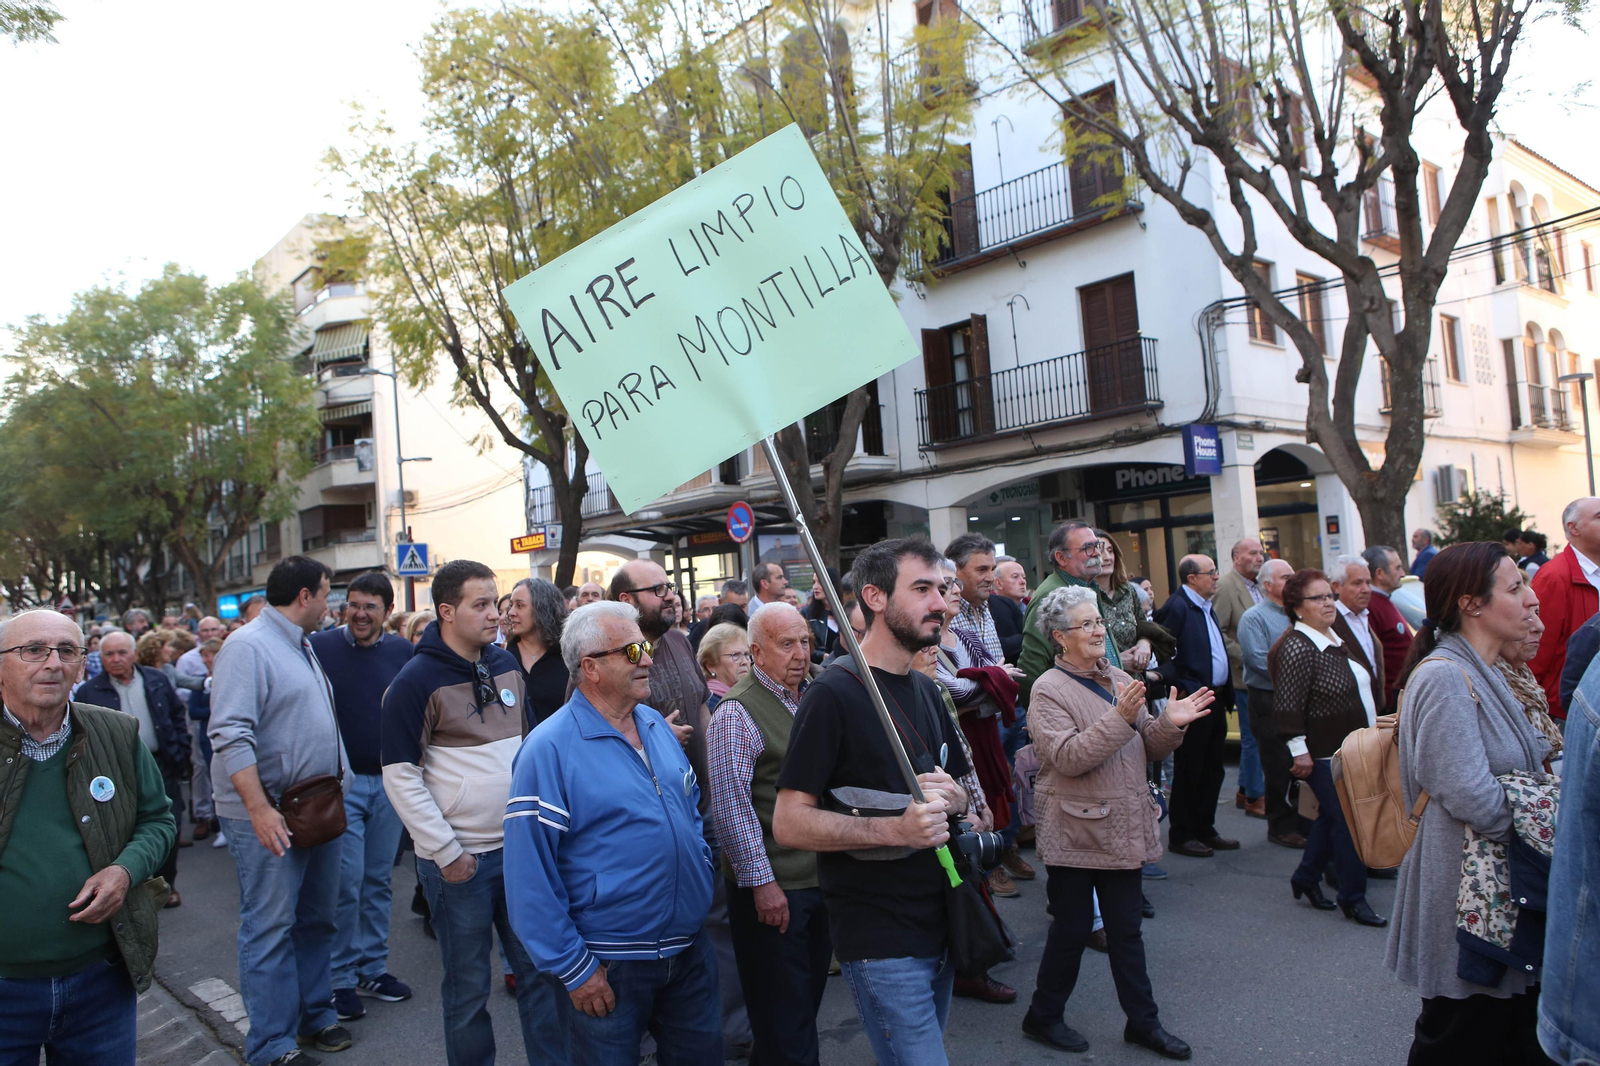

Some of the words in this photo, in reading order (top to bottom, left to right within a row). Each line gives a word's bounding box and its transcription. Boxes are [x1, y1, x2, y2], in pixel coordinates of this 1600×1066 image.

[541, 256, 656, 371] AIRE
[667, 175, 806, 277] LIMPIO
[581, 364, 677, 440] PARA
[676, 233, 874, 382] MONTILLA
[1193, 435, 1216, 447] Phone
[1194, 446, 1217, 457] House
[1115, 465, 1185, 490] Phone
